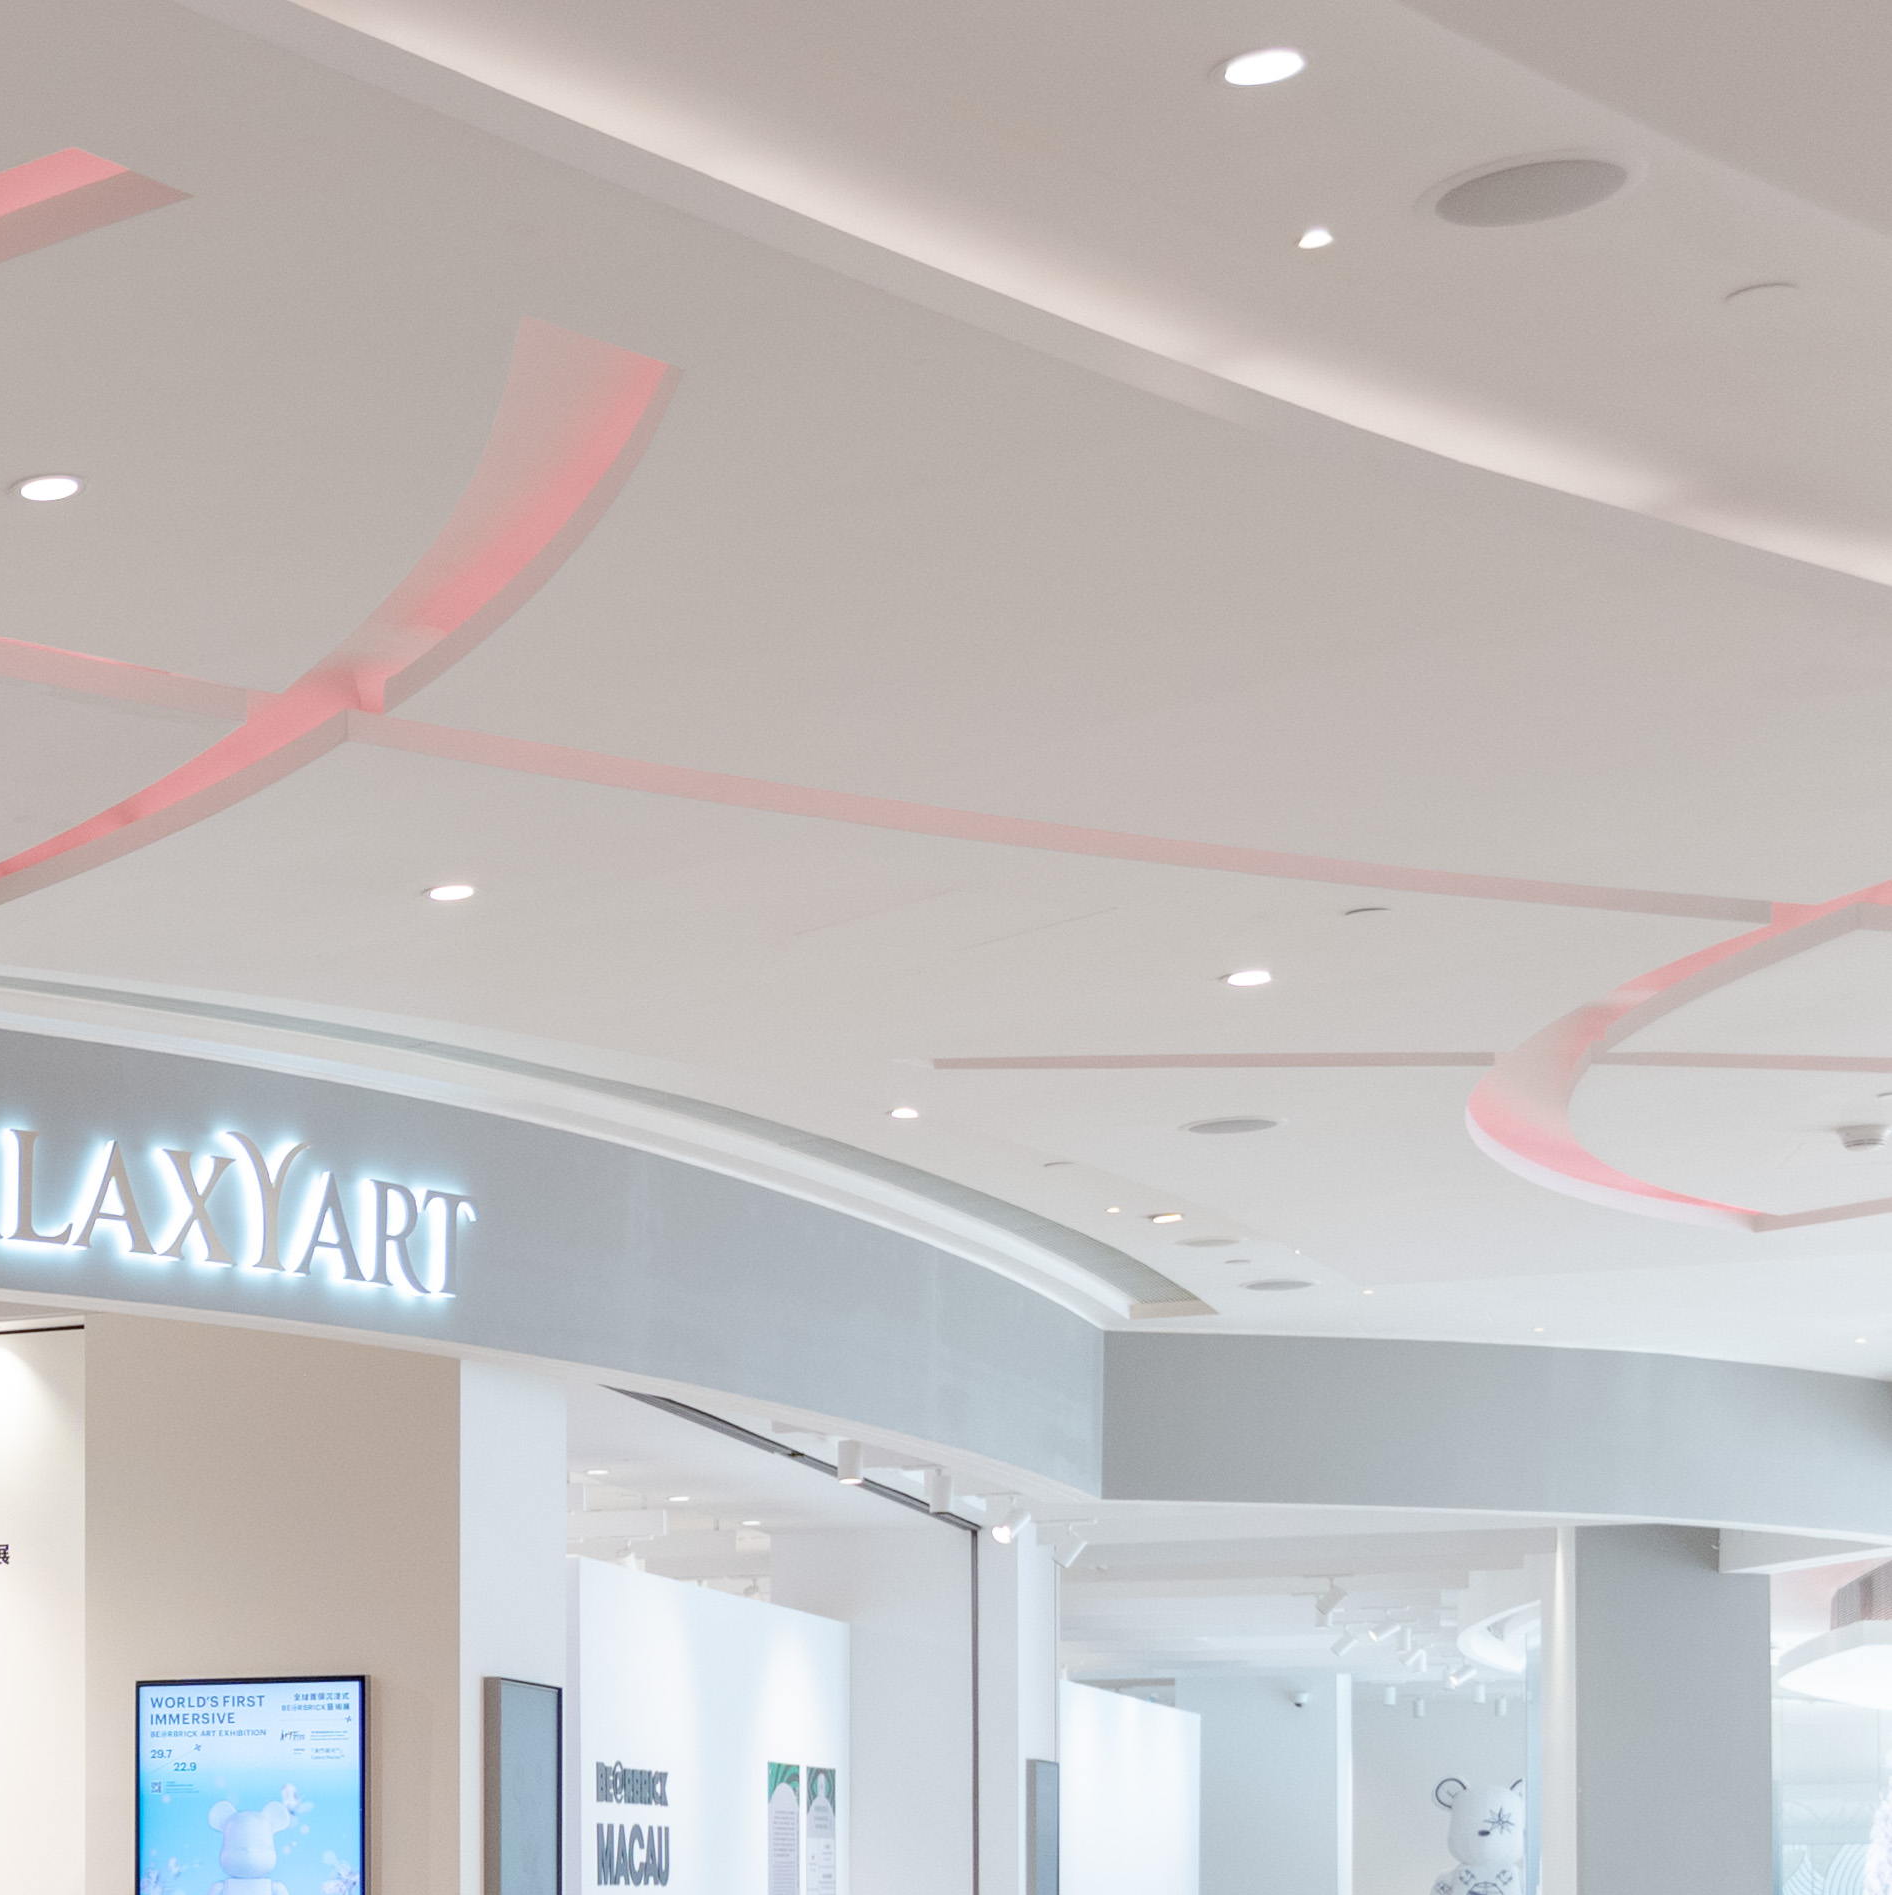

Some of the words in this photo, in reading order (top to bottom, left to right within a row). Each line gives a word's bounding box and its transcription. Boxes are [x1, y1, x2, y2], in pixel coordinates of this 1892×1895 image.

[151, 1695, 219, 1708] WORLD'S
[223, 1695, 265, 1707] FIRST
[150, 1713, 235, 1725] IMMERSIVE
[151, 1730, 197, 1738] BE@RBRICK
[219, 1729, 267, 1737] EXHIBITION
[151, 1749, 172, 1759] 29.7
[174, 1762, 197, 1771] 22.9
[596, 1761, 668, 1806] BE@RBRICK
[597, 1823, 669, 1886] MACAU
